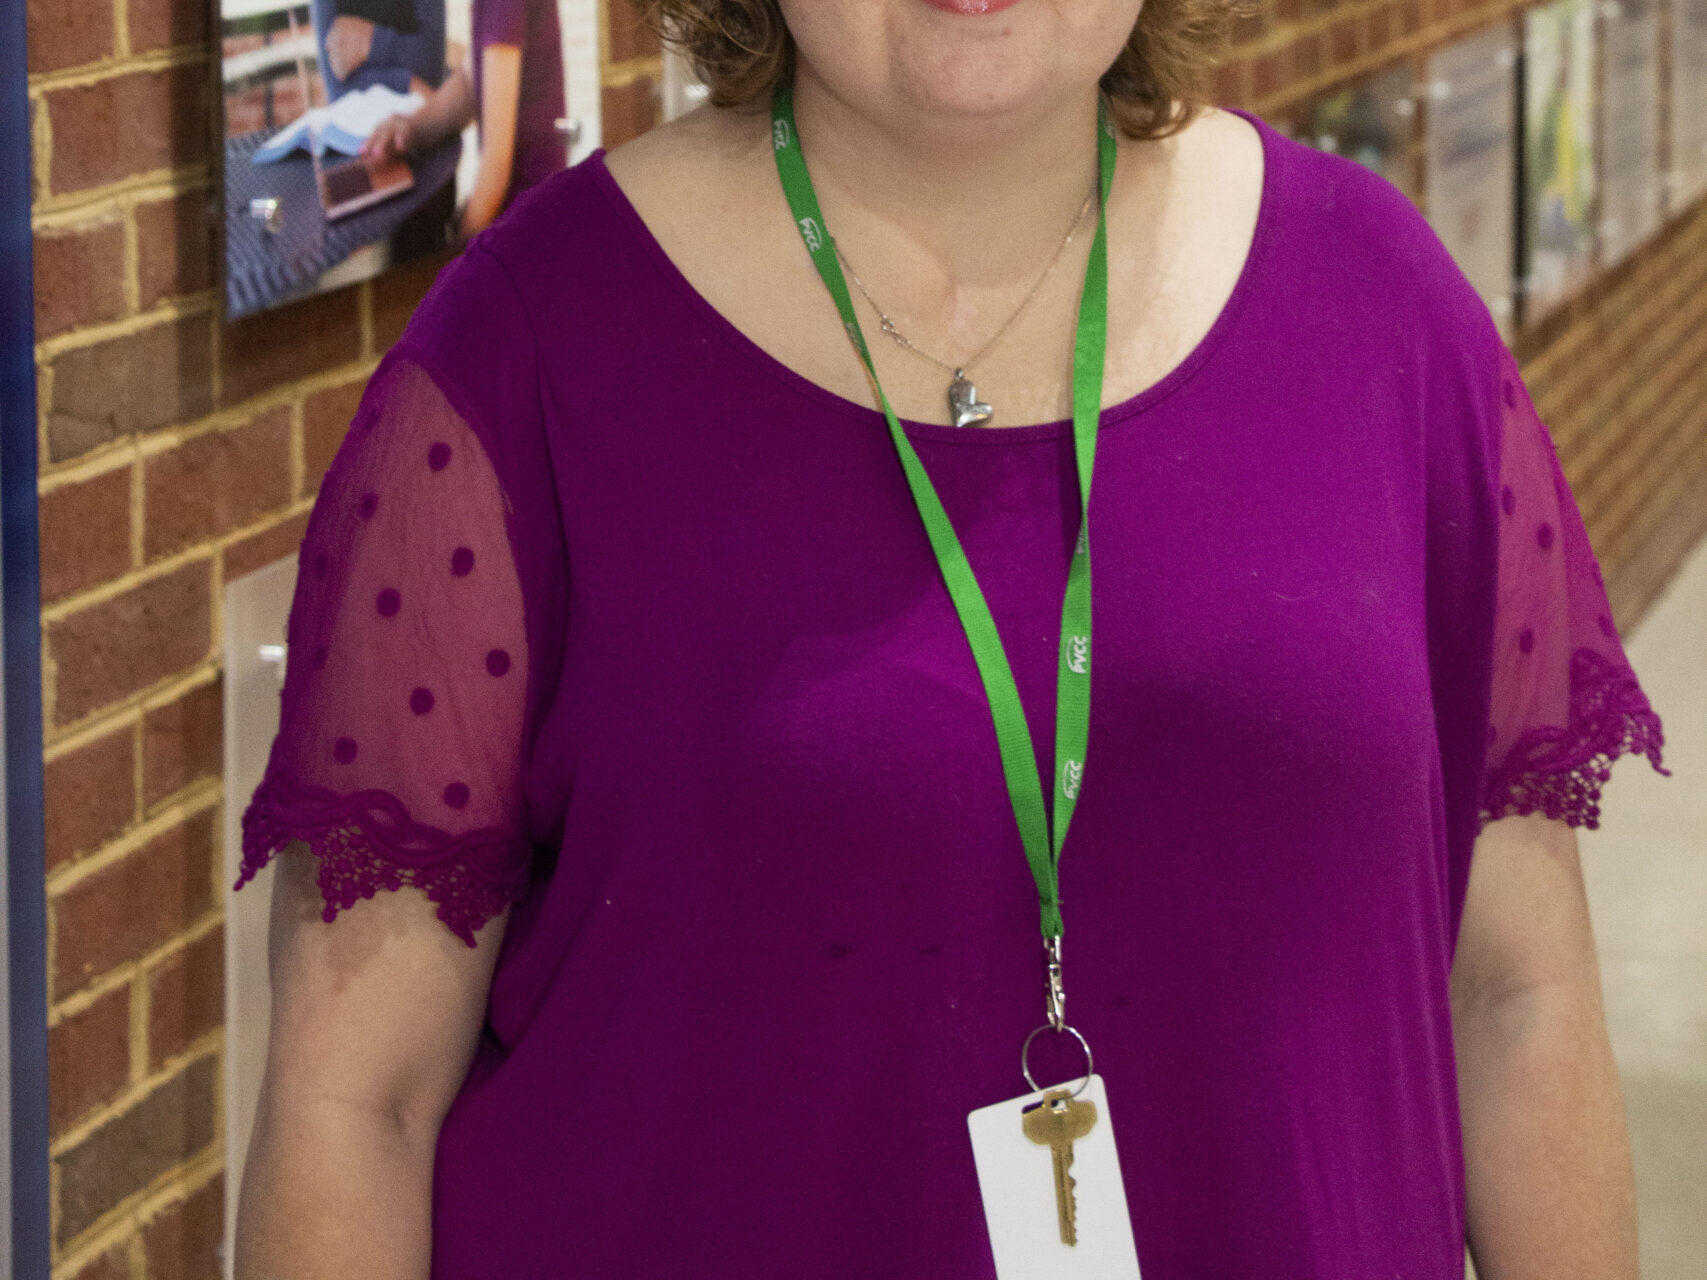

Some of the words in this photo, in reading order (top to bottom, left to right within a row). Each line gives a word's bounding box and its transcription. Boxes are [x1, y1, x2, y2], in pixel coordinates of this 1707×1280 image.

[800, 218, 821, 252] PVCC
[1068, 635, 1087, 674] PVCC
[1064, 760, 1082, 799] PVCC
